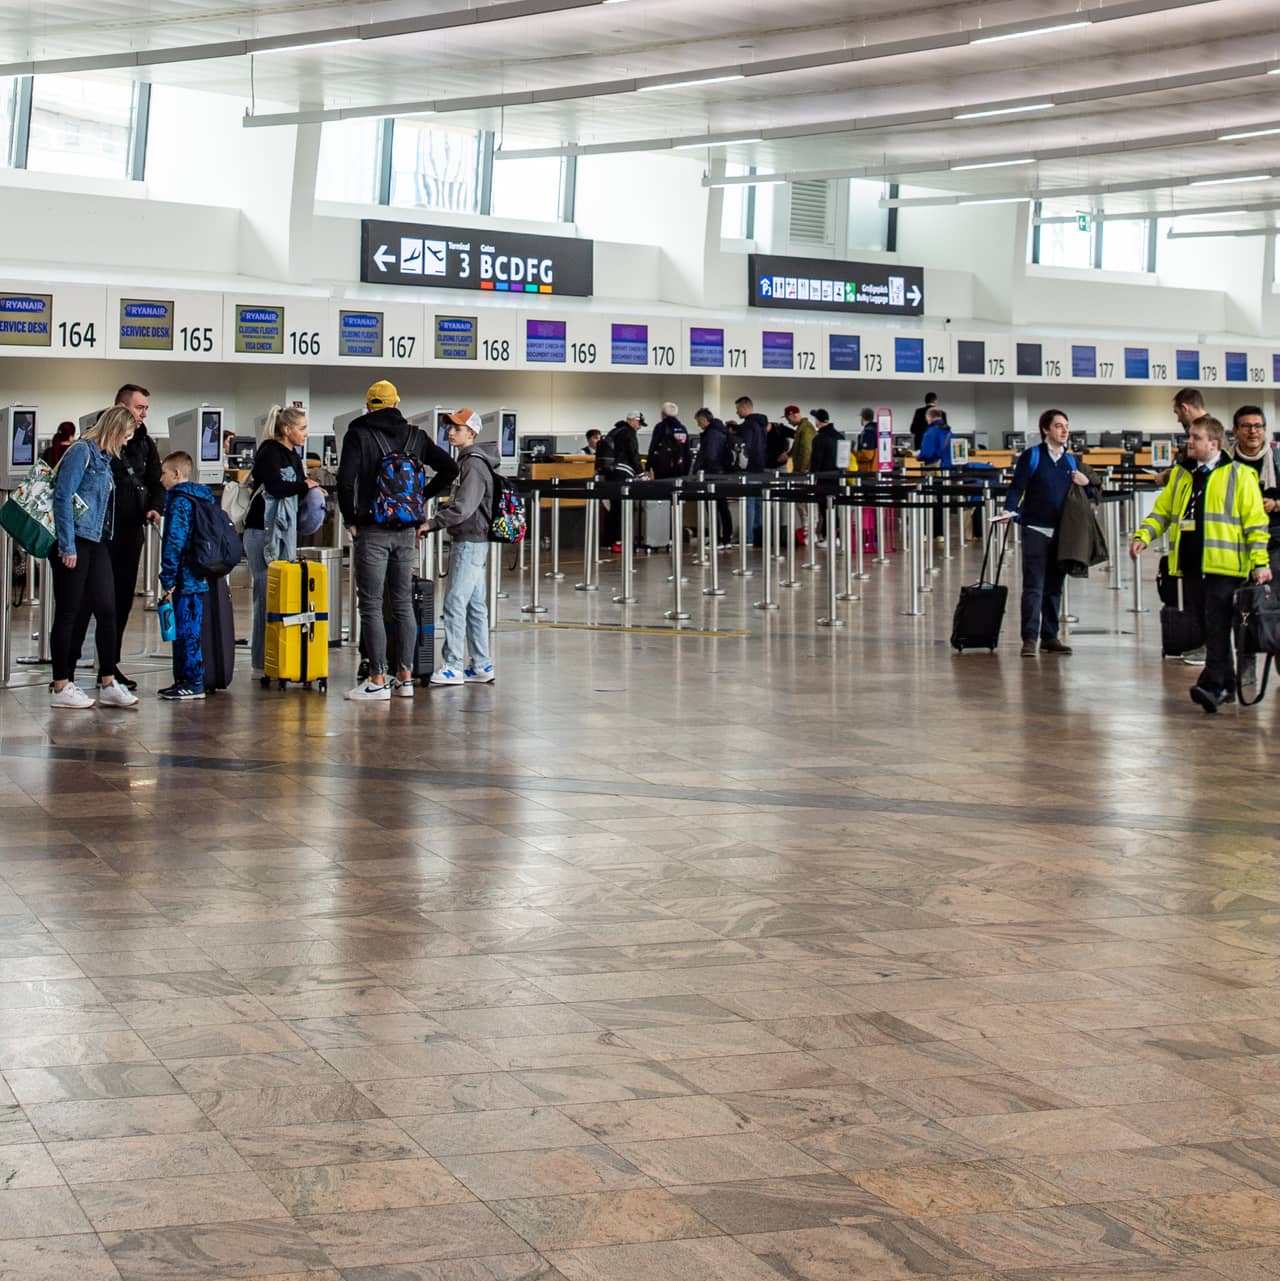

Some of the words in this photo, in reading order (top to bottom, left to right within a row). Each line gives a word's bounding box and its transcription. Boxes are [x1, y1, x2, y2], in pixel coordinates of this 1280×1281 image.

[459, 253, 470, 278] 3
[5, 301, 43, 311] RYANAIR
[132, 307, 166, 316] RYANAIR
[246, 312, 277, 320] RYANAIR
[27, 322, 48, 334] DESK
[58, 322, 96, 348] 164
[121, 325, 152, 337] SERVICE
[152, 326, 170, 338] DESK
[179, 327, 213, 352] 165
[289, 331, 320, 356] 166
[389, 336, 416, 358] 167
[482, 340, 510, 361] 168
[571, 343, 596, 363] 169
[652, 346, 675, 366] 170
[728, 349, 747, 368] 171
[797, 352, 815, 370] 172
[864, 354, 882, 372] 173
[928, 357, 944, 373] 174
[989, 359, 1004, 376] 175
[1045, 361, 1061, 377] 176
[1099, 363, 1114, 378] 177
[1152, 365, 1167, 380] 178
[1202, 366, 1217, 381] 179
